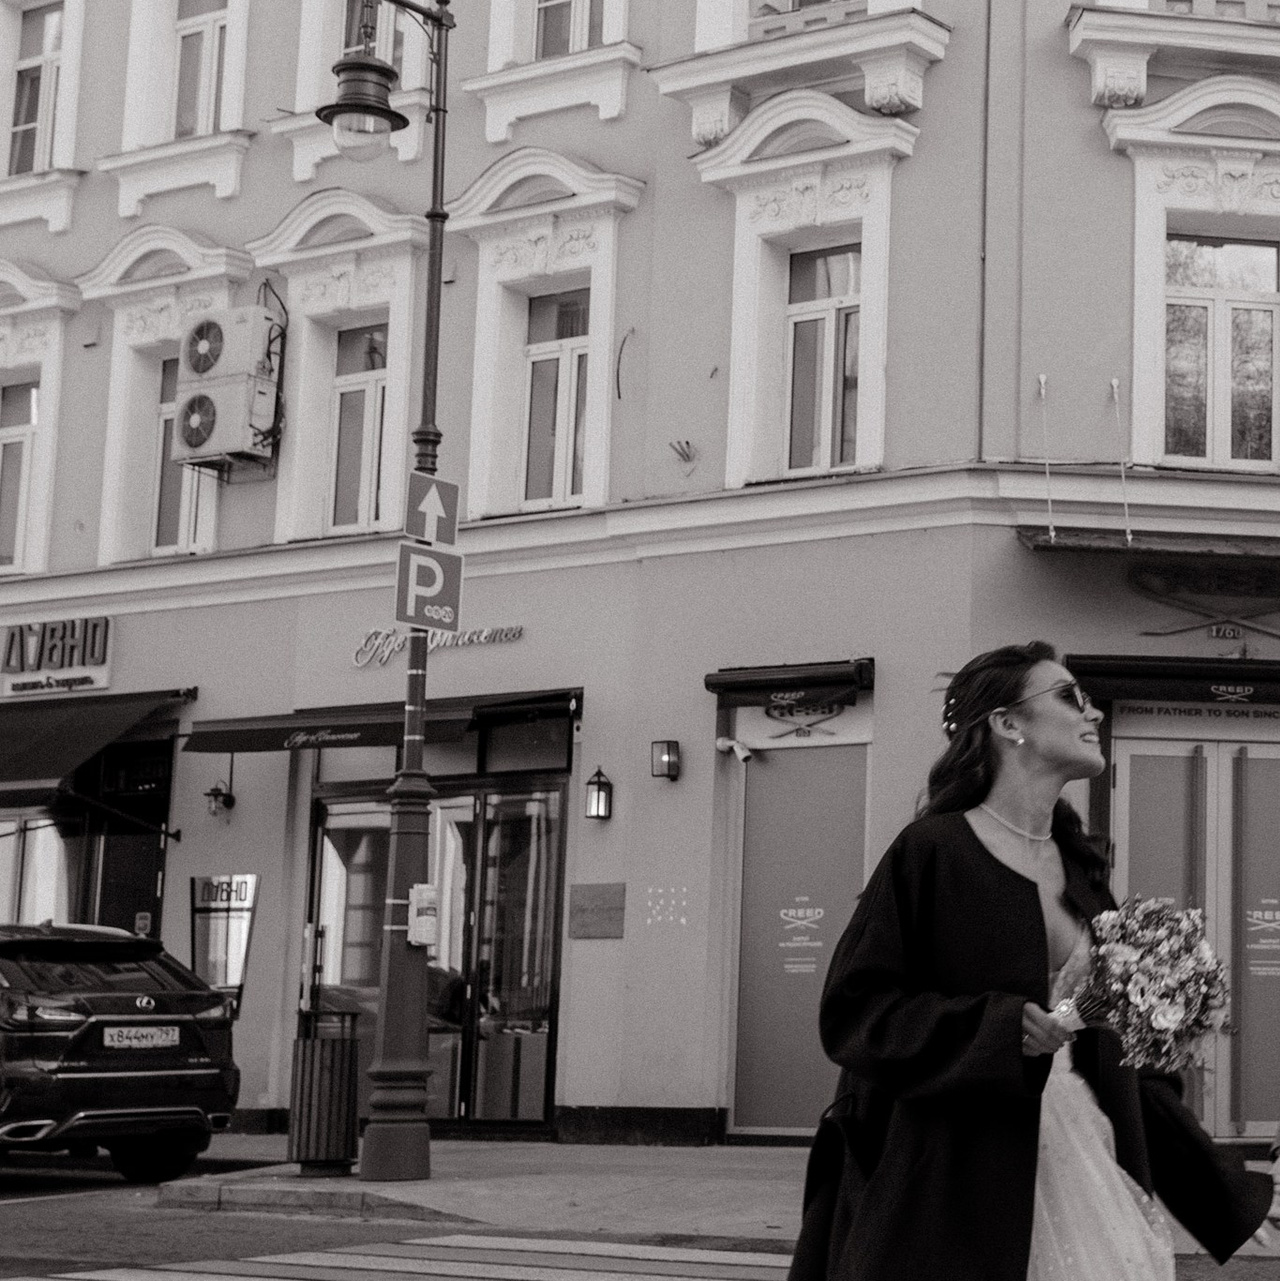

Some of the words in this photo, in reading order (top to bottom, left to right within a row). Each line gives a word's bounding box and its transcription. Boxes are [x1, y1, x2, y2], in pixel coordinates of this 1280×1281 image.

[407, 553, 444, 617] P
[1210, 685, 1254, 694] CREED
[1119, 705, 1154, 715] FROM
[1157, 706, 1201, 717] FATHER
[1207, 709, 1222, 717] TO
[1225, 709, 1250, 718] SON
[780, 908, 824, 919] CREED
